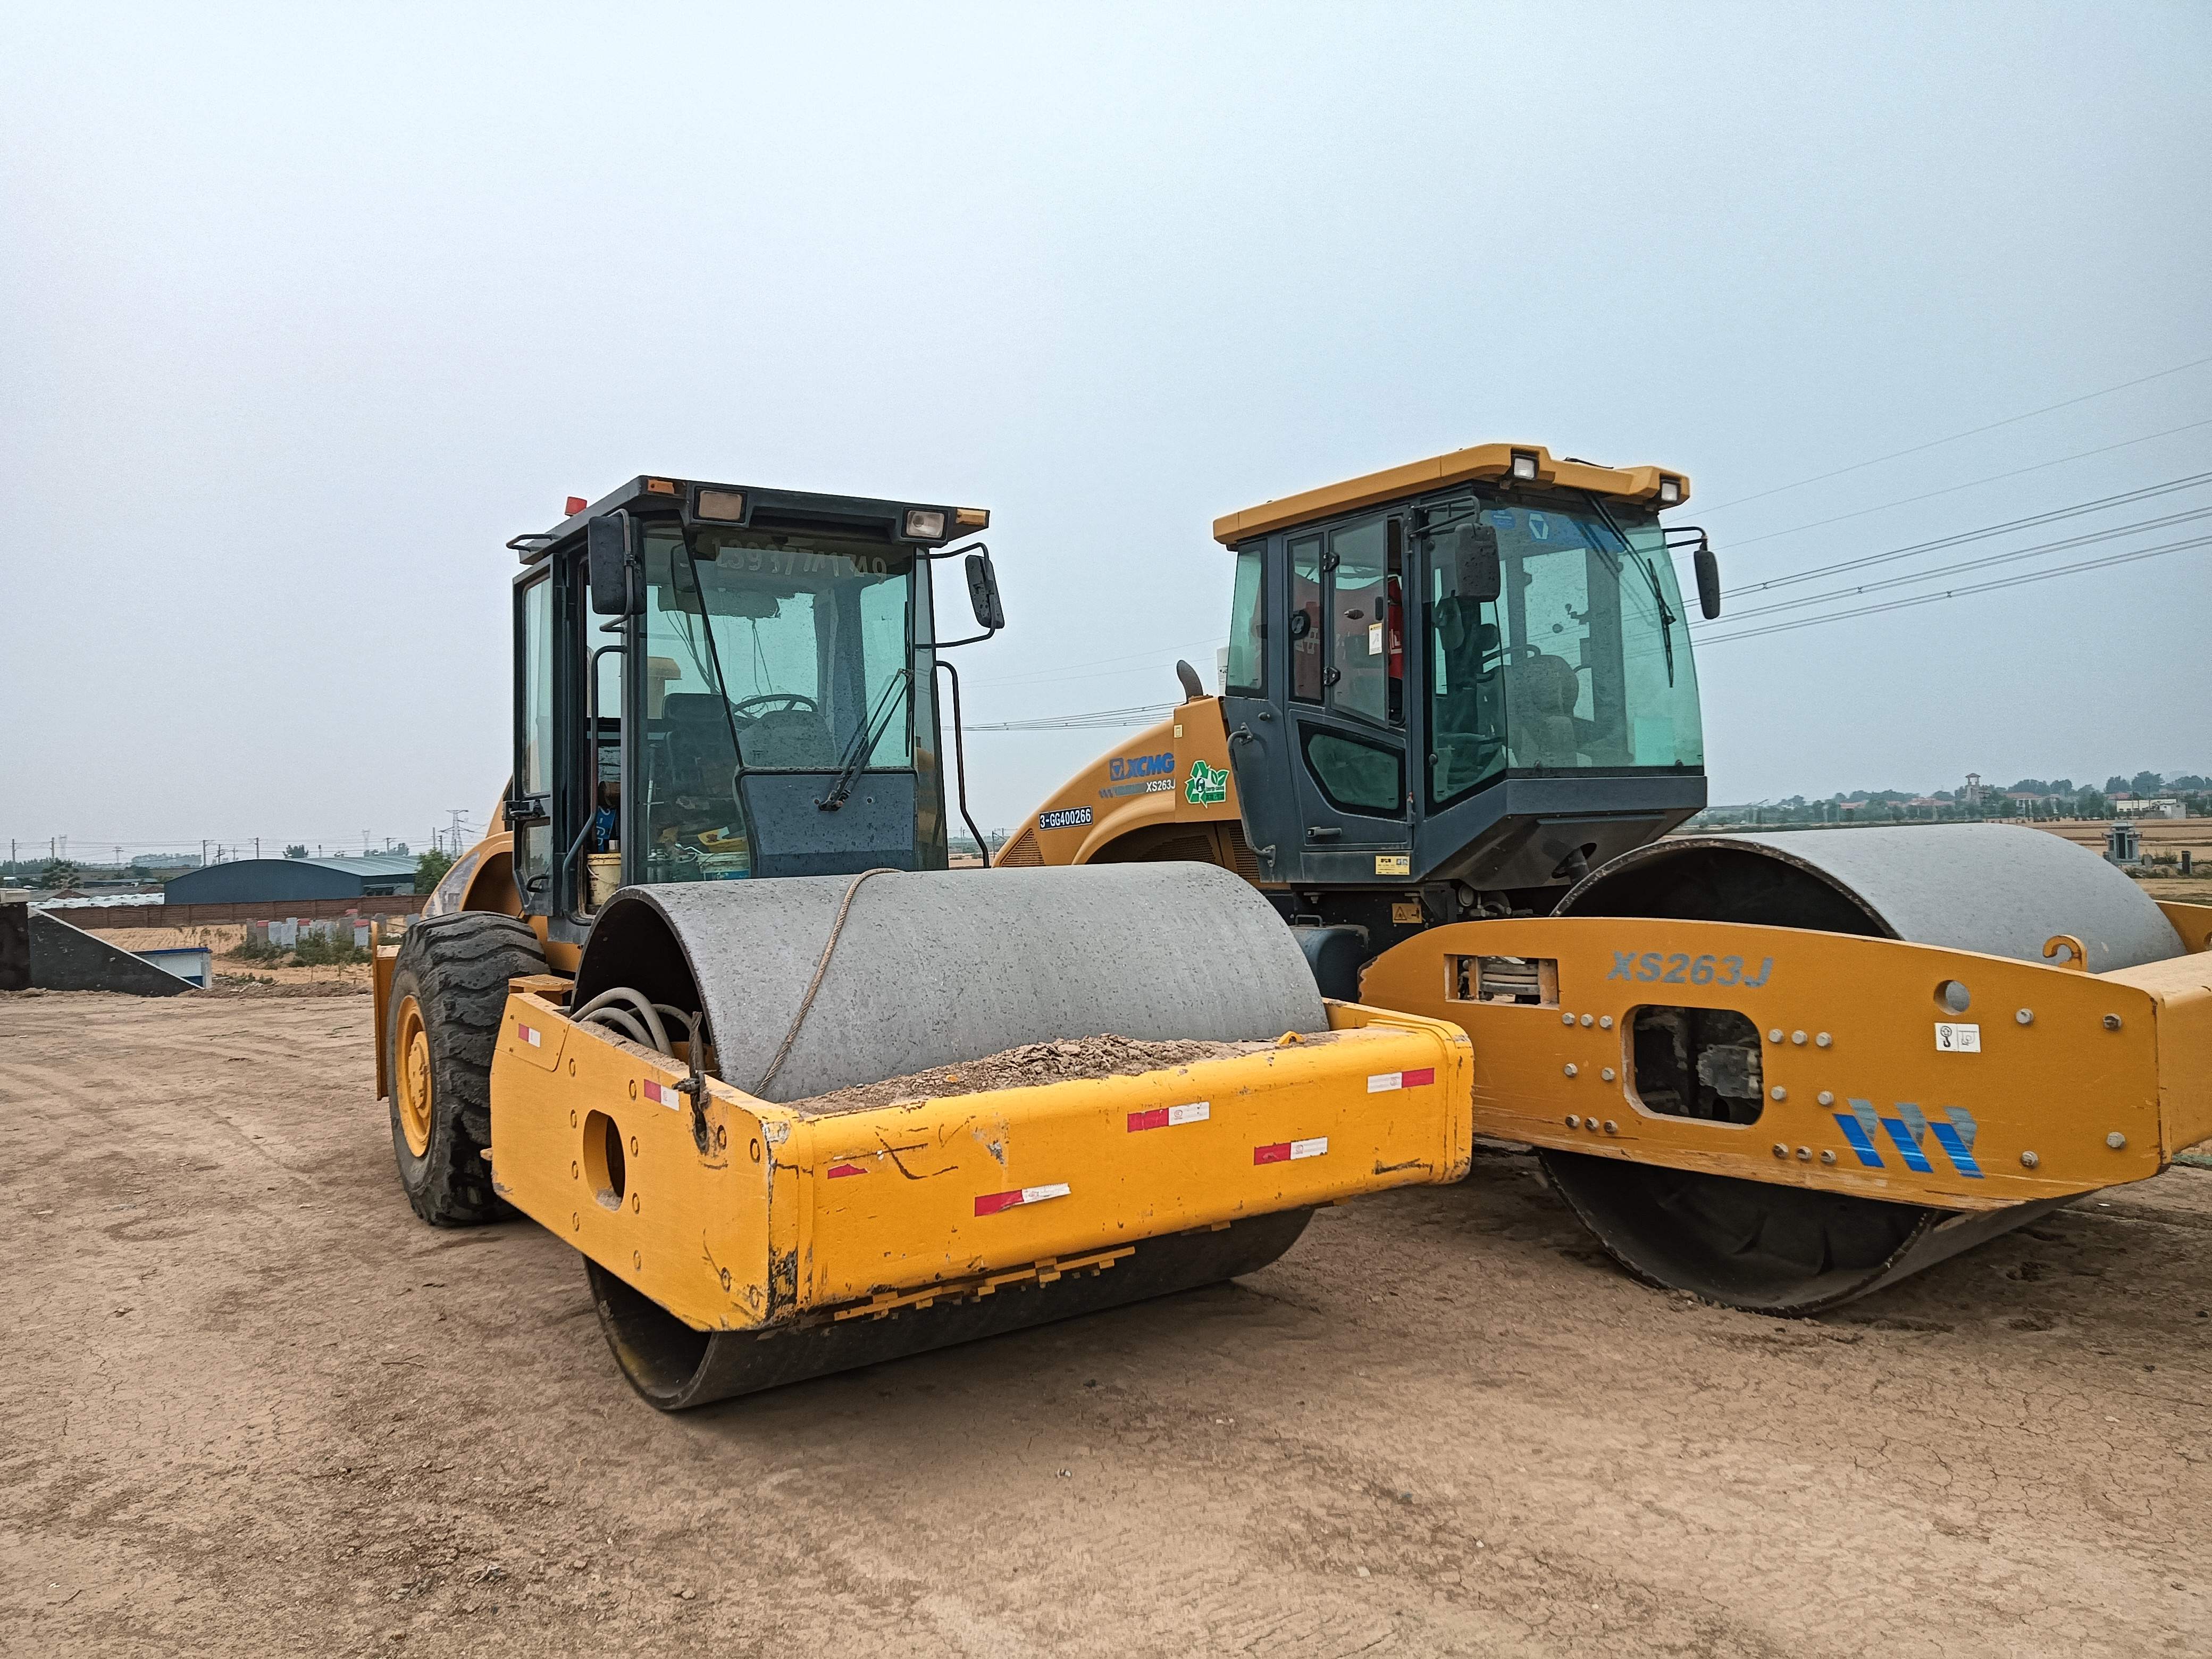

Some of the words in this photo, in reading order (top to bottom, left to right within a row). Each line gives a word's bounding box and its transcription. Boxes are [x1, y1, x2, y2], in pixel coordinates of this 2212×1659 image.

[1125, 752, 1175, 778] XCMG
[1146, 778, 1176, 793] XS263J
[1040, 808, 1091, 828] 3-GG400266
[1606, 950, 1774, 988] XS263J
